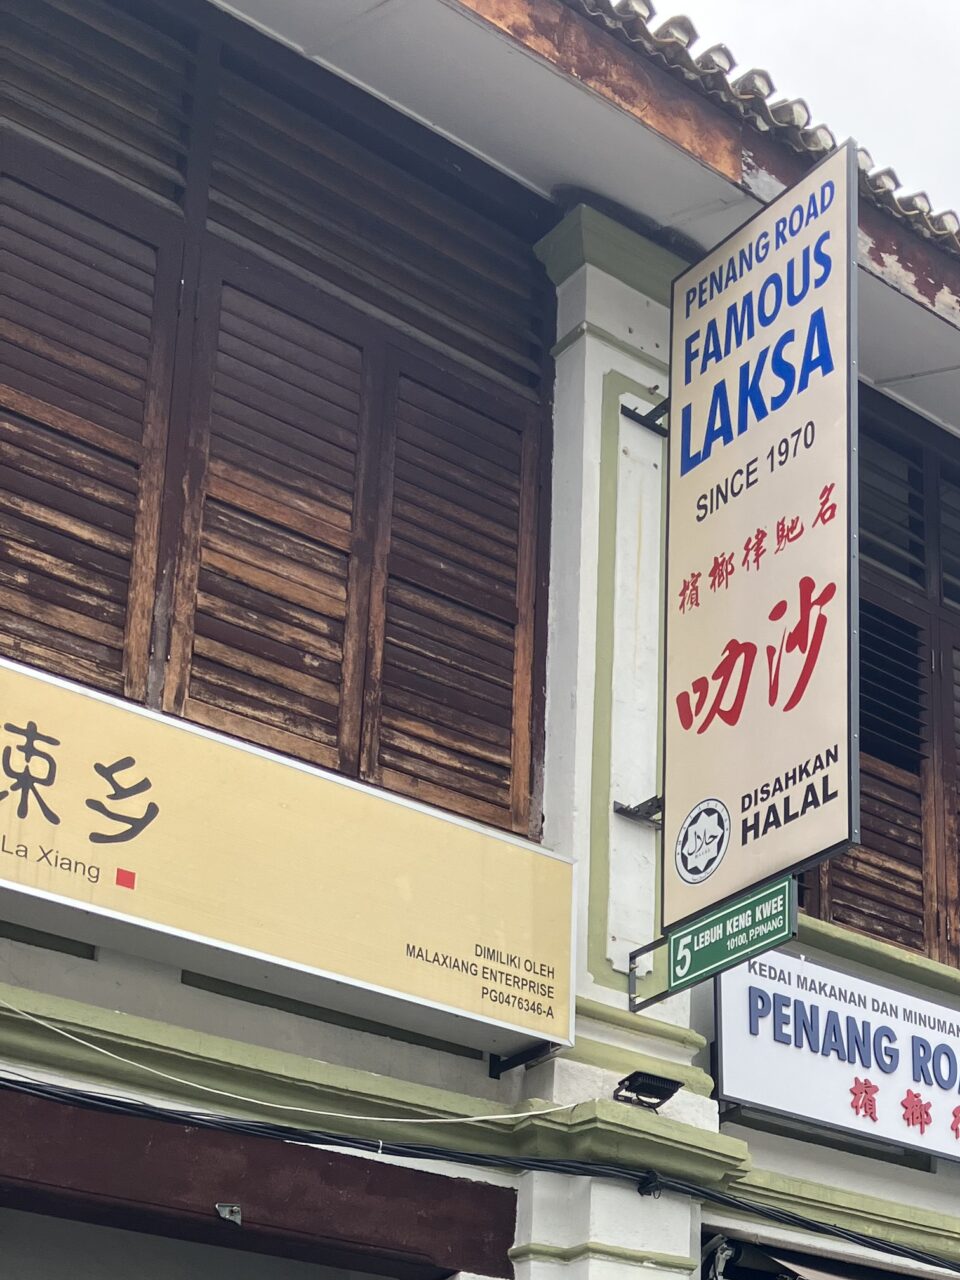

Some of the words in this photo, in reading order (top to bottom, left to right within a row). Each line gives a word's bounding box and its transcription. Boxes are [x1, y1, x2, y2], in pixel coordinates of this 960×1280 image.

[685, 231, 769, 319] PENANG
[775, 180, 835, 253] ROAD
[684, 230, 832, 386] FAMOUS
[680, 306, 835, 477] LAKSA
[696, 457, 759, 522] SINCE
[766, 420, 815, 473] 1970
[676, 575, 837, 735] 叻沙
[741, 744, 839, 813] DISAHKAN
[741, 774, 838, 846] HALAL
[1, 834, 28, 859] La
[36, 844, 101, 884] Xiang
[406, 944, 478, 976] MALAXIANG
[482, 966, 555, 999] ENTERPRISE
[475, 944, 521, 970] DIMILIKI
[524, 959, 555, 980] OLEH
[675, 935, 692, 977] 5
[694, 923, 723, 951] LEBUH
[726, 910, 752, 935] KENG
[756, 895, 783, 922] KWEE
[726, 933, 748, 950] 10100,
[481, 987, 554, 1019] PG0476346-A
[748, 960, 792, 985] KEDAI
[797, 975, 867, 1009] MAKANAN
[872, 998, 899, 1019] DAN
[748, 985, 899, 1074] PENANG
